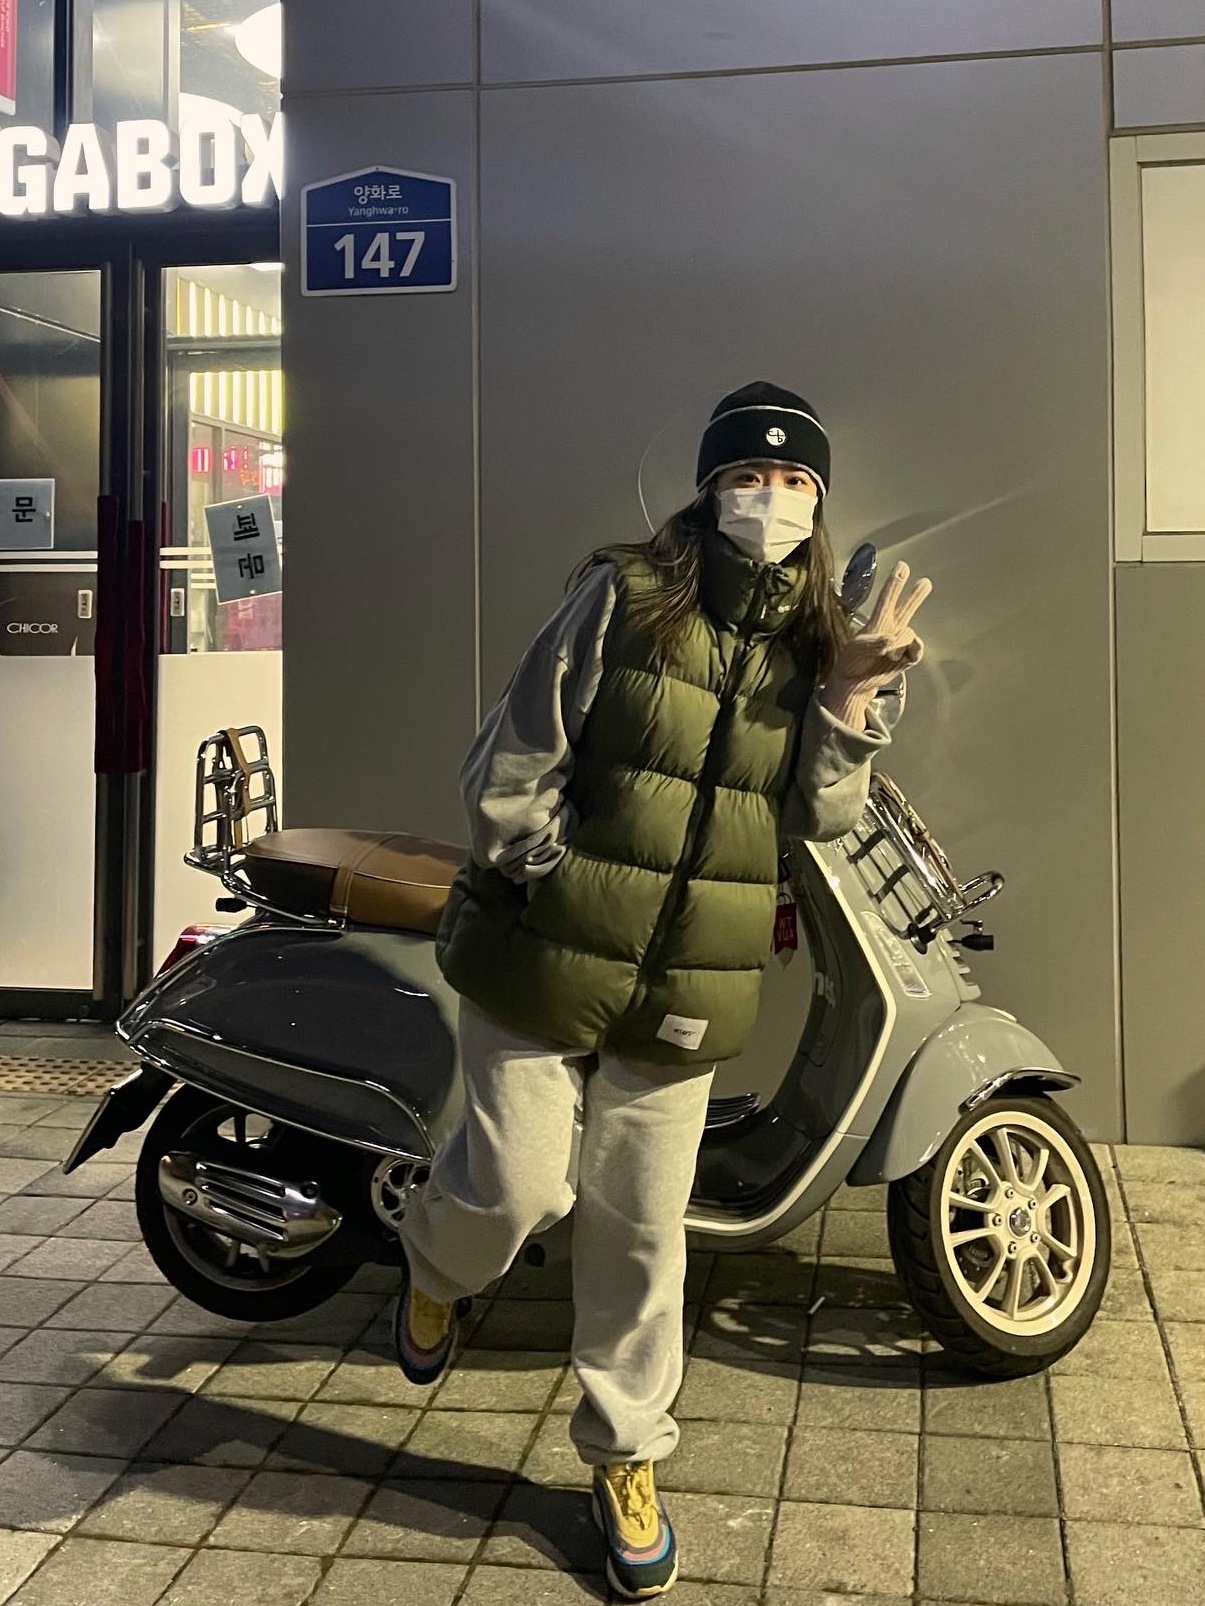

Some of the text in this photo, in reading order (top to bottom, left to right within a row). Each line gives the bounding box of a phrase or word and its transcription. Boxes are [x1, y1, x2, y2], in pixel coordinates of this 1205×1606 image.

[0, 112, 284, 216] GABOX
[354, 184, 403, 205] 양화로
[348, 205, 409, 218] Yanghwa-ro
[333, 231, 426, 279] 147
[12, 496, 36, 523] 문
[6, 622, 59, 635] CHICOR
